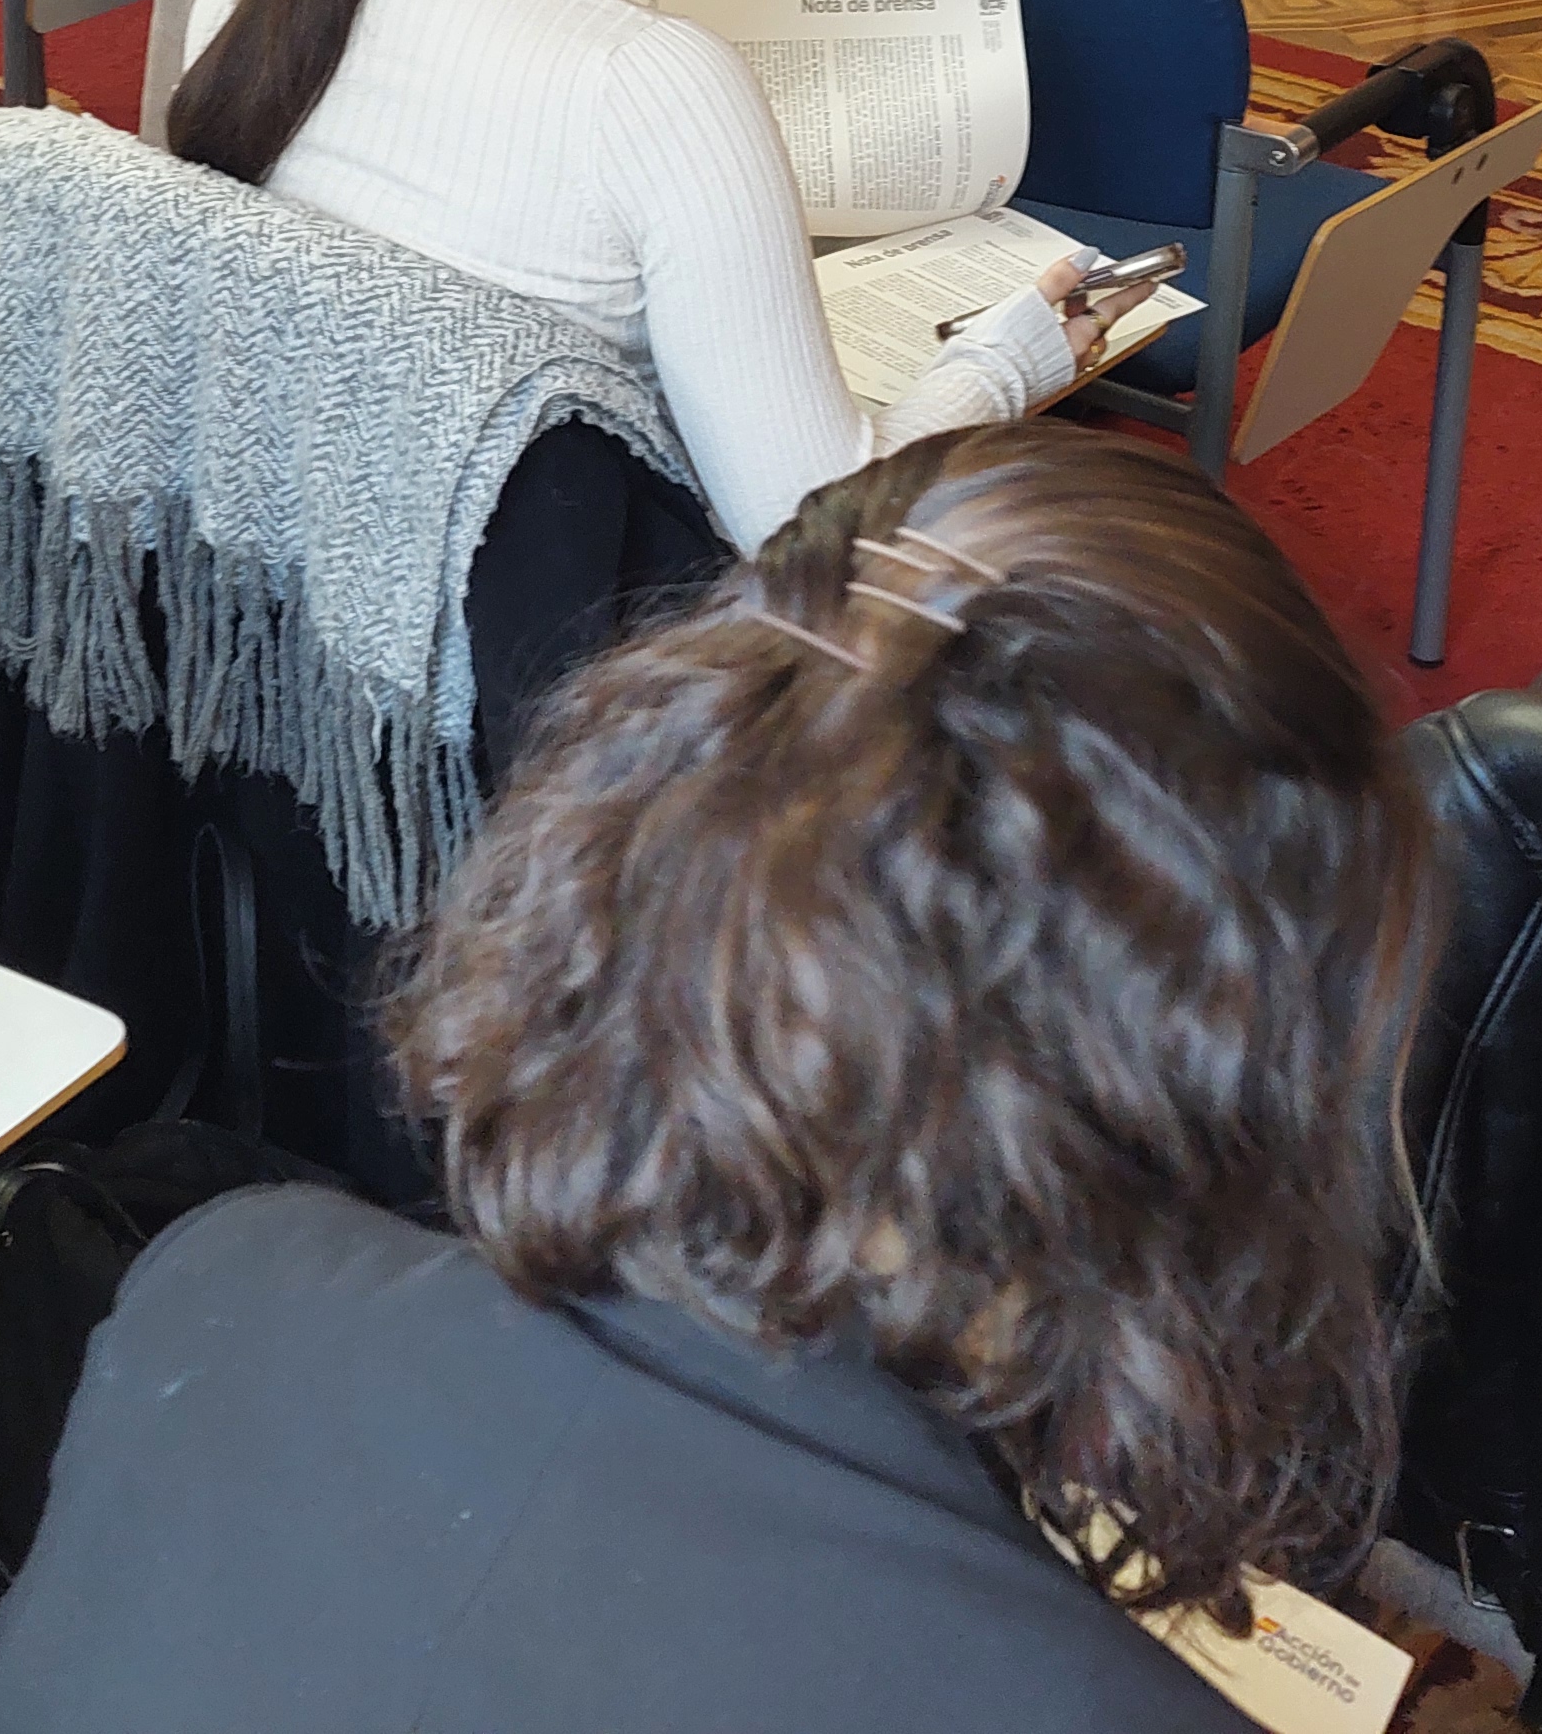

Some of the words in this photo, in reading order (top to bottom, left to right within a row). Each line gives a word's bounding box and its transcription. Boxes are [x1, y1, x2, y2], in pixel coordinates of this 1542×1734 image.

[843, 253, 885, 269] Nota
[883, 247, 899, 258] de
[901, 228, 954, 253] prensa
[1257, 1634, 1356, 1704] Gobierno
